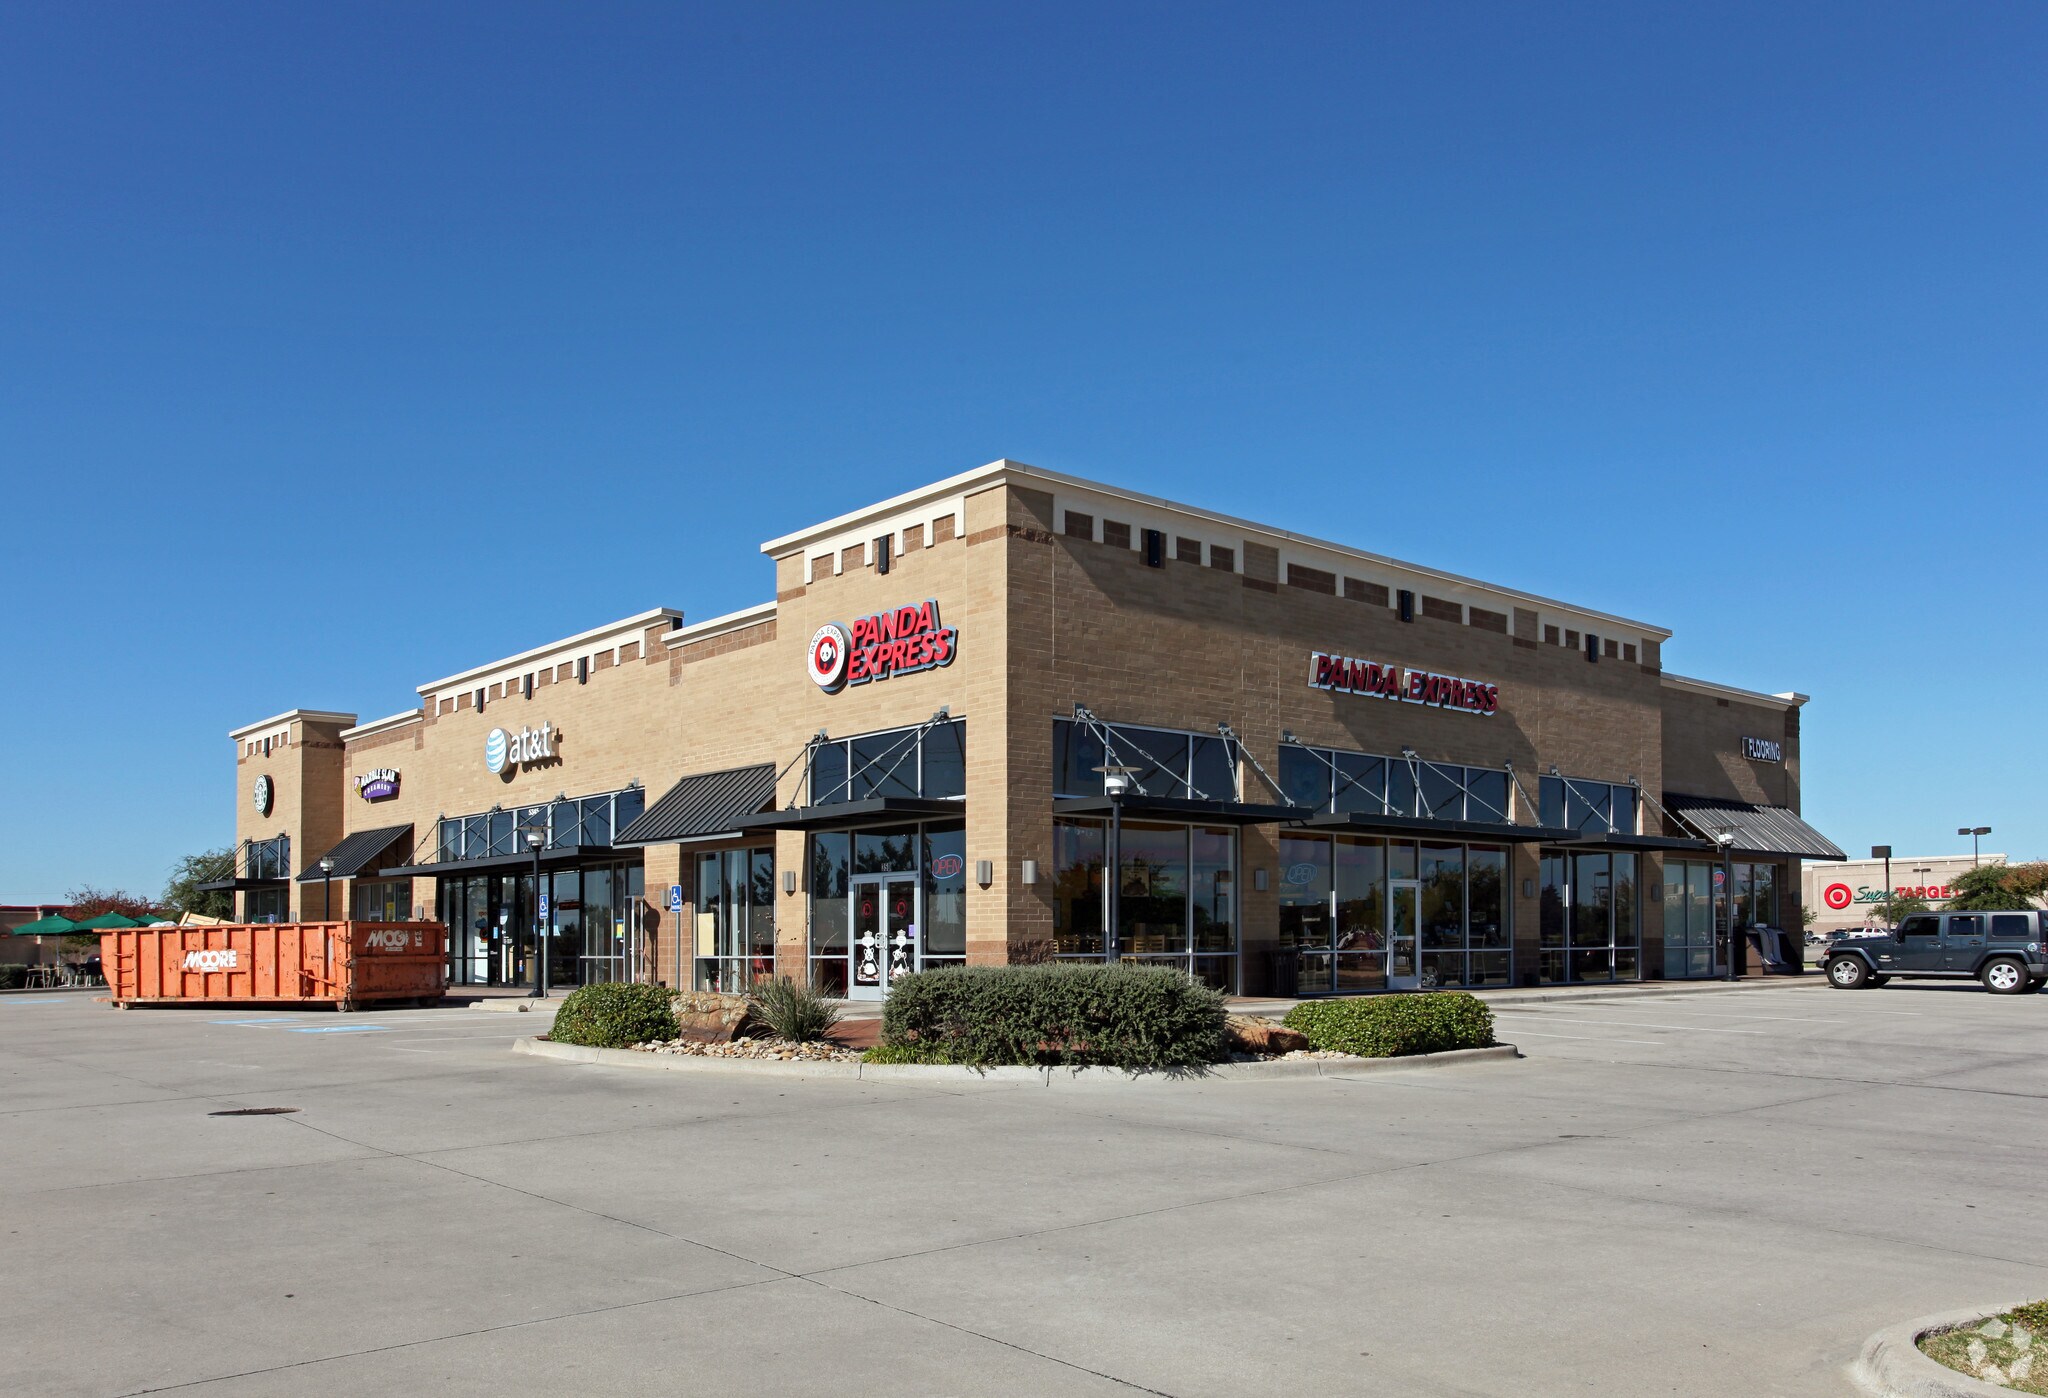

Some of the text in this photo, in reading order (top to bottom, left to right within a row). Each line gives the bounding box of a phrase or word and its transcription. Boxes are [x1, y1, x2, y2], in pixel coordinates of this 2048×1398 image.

[851, 601, 934, 649] PANDA
[809, 626, 844, 654] PANDA EXPRESS
[847, 629, 951, 680] EXPRESS
[1315, 655, 1499, 712] PANDA EXPRESS
[509, 720, 551, 764] at&t
[1748, 738, 1780, 761] FLOORING
[932, 858, 961, 875] OPEN
[1287, 866, 1315, 881] OPEN
[182, 950, 237, 968] MOORE
